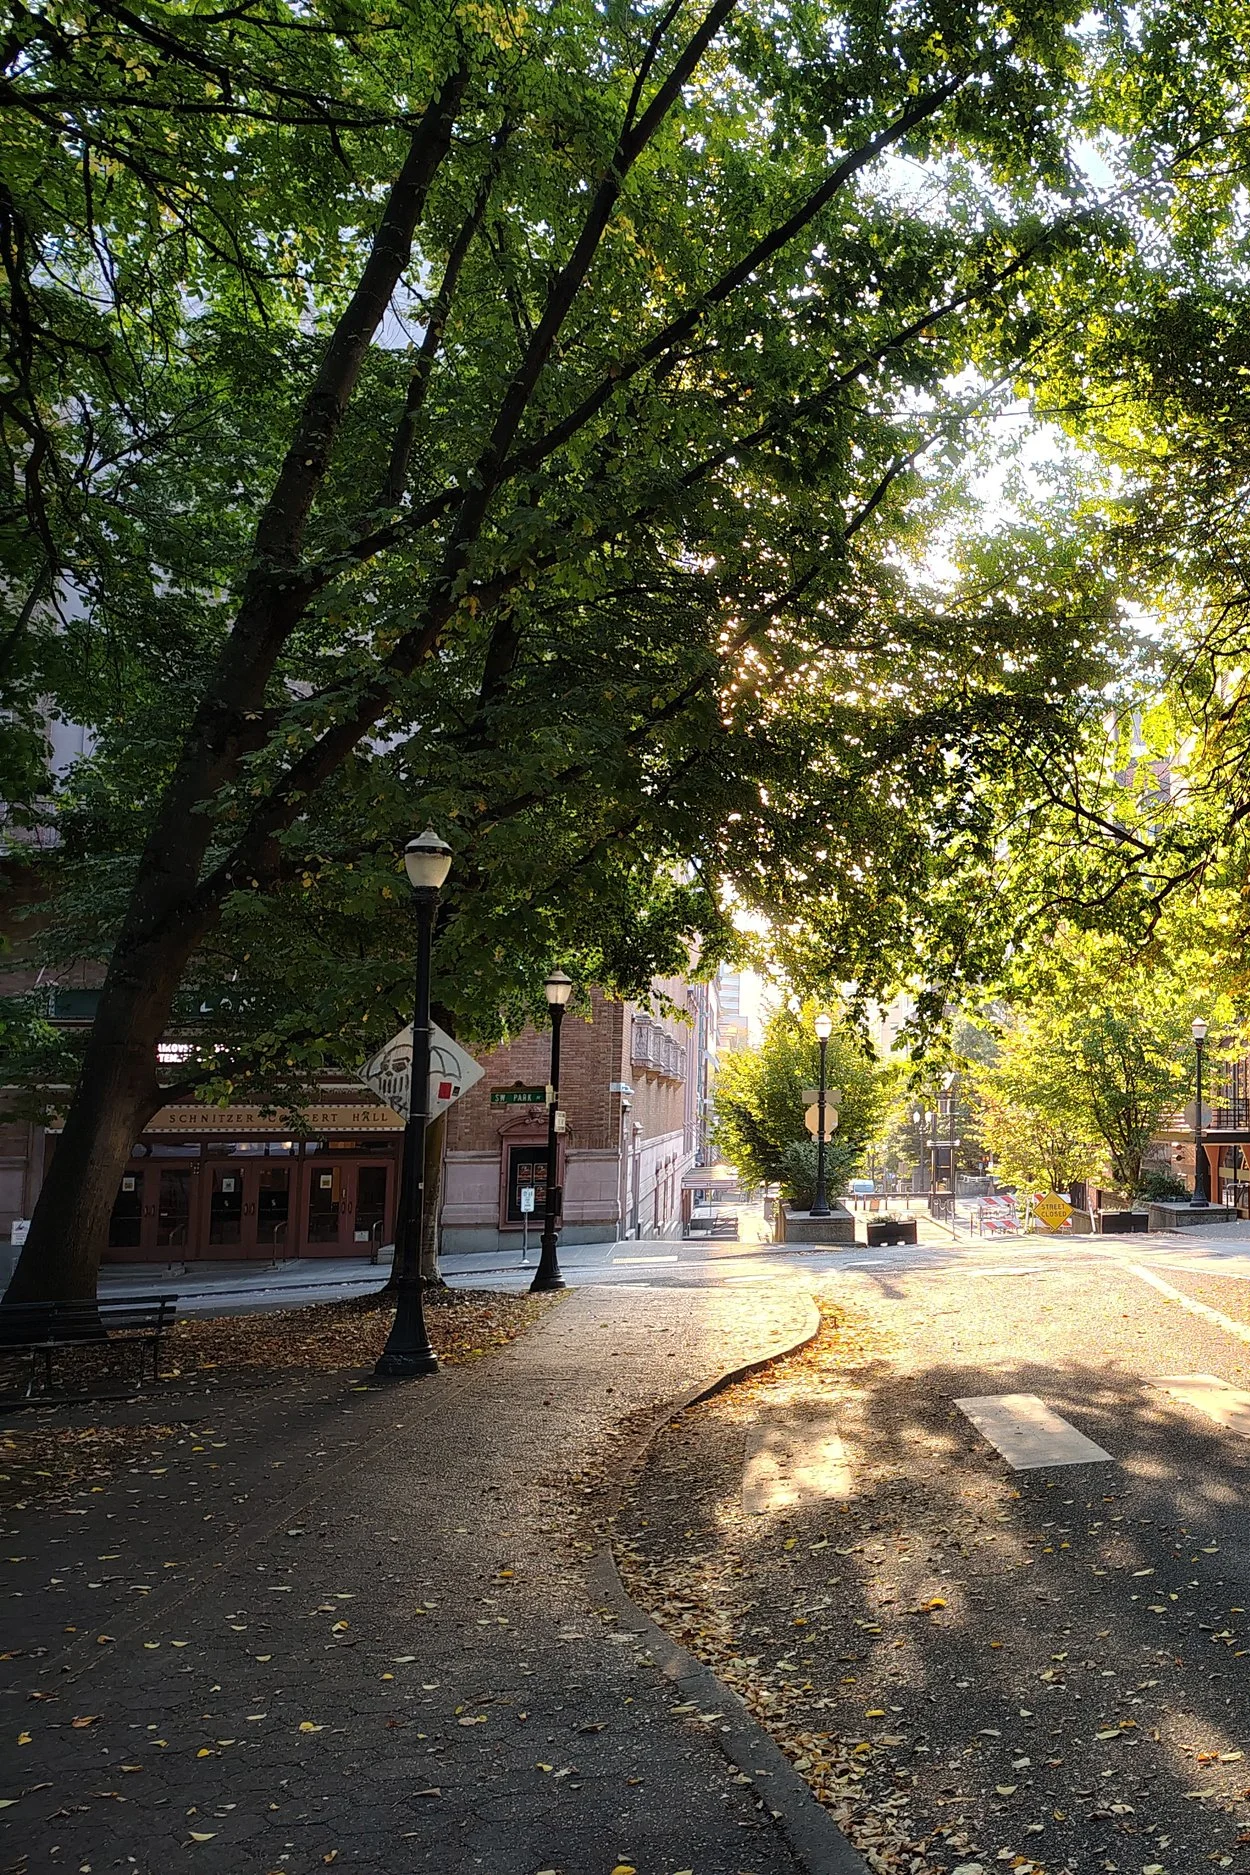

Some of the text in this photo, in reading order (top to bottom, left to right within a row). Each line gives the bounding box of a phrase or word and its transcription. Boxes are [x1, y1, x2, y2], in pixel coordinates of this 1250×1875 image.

[494, 1093, 506, 1102] SW
[513, 1093, 532, 1102] PARK
[169, 1112, 388, 1123] SCHNITZER COCERT HALL
